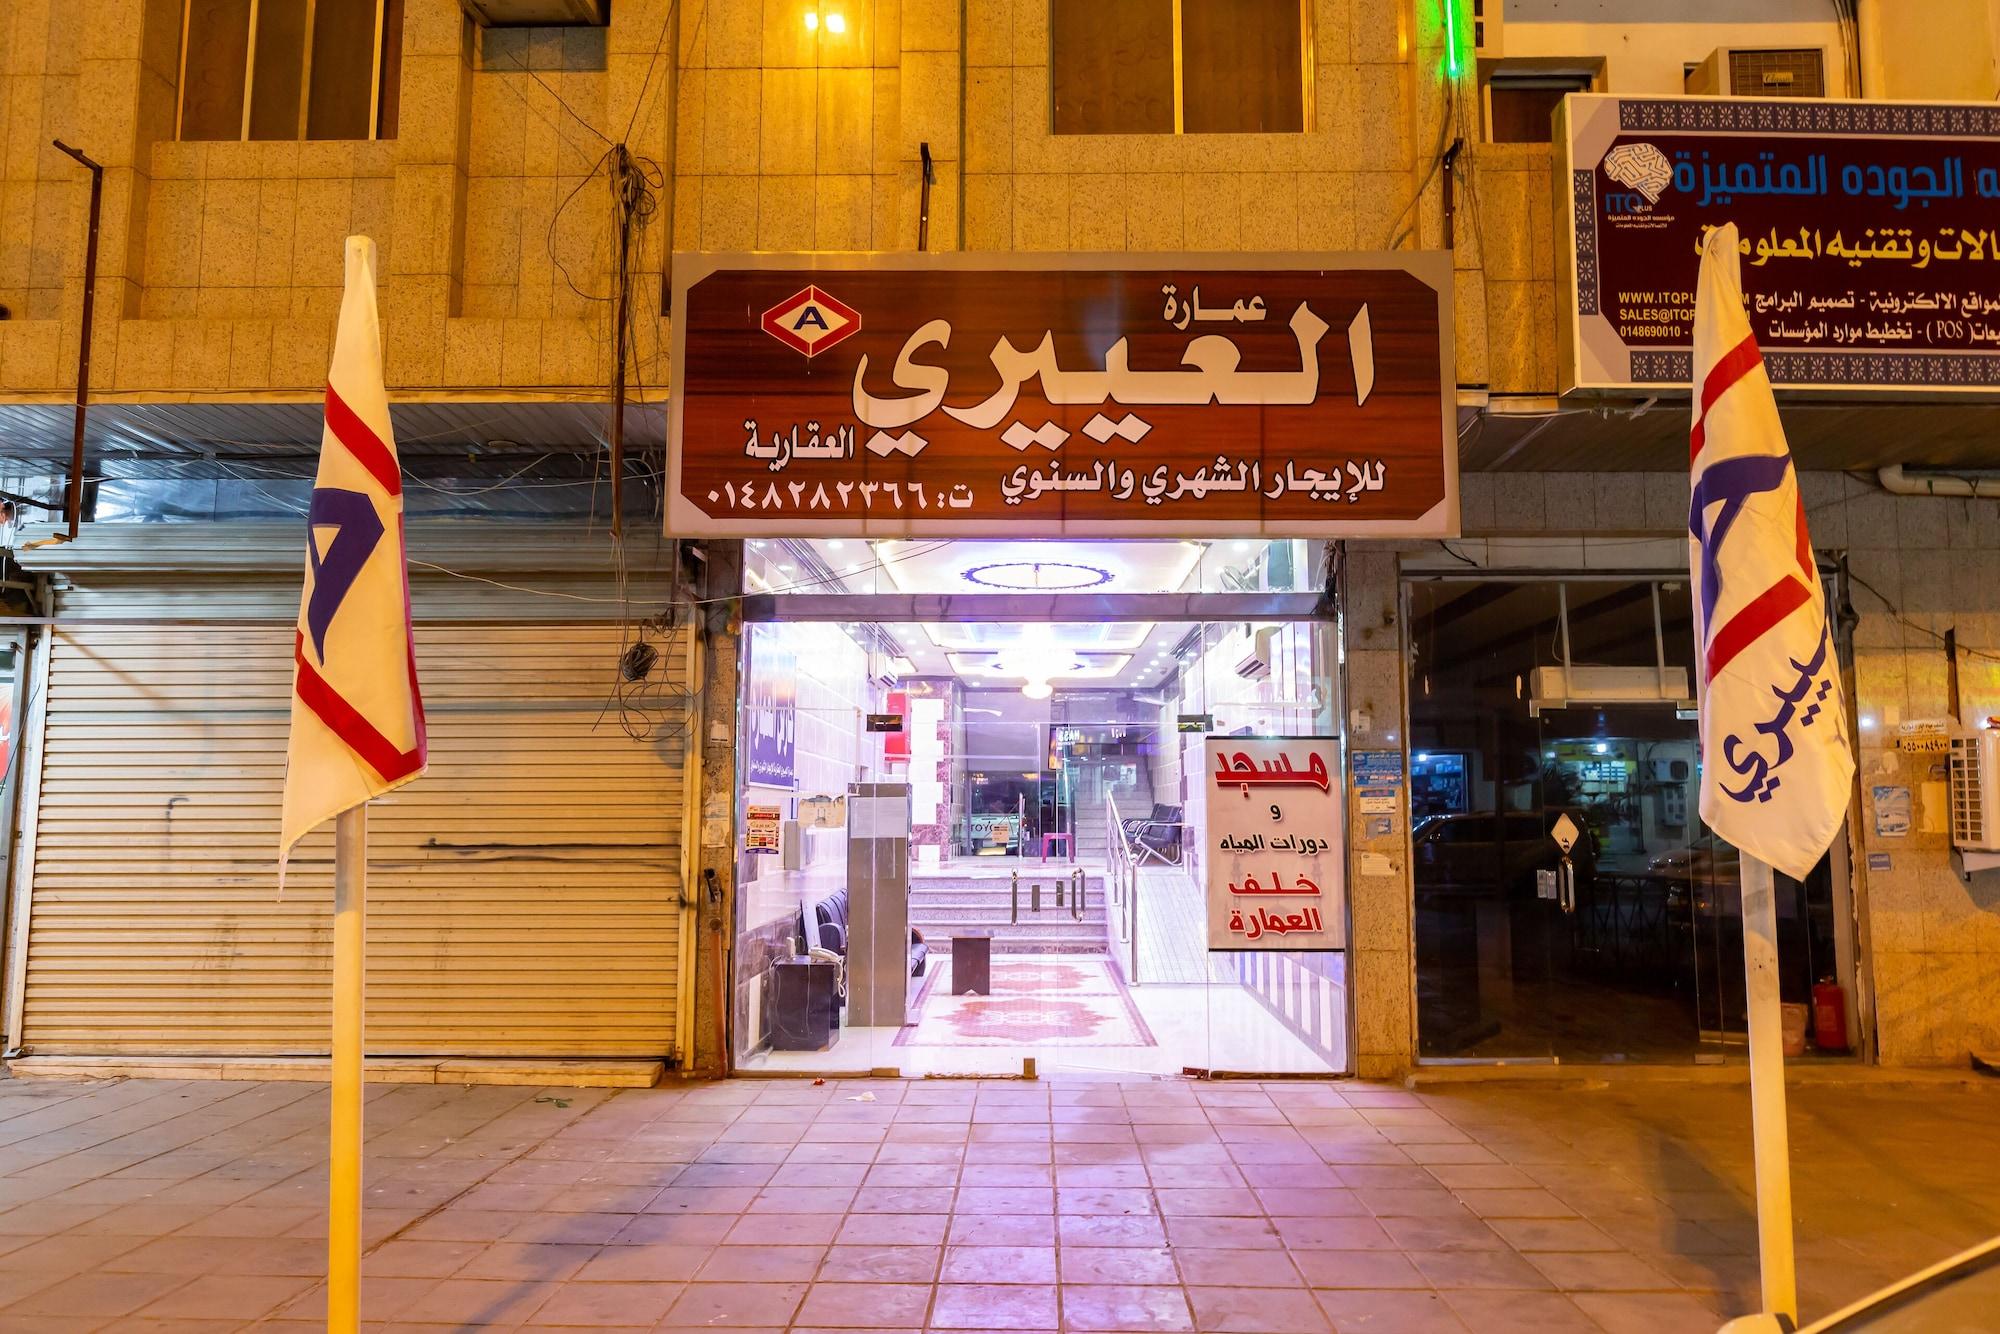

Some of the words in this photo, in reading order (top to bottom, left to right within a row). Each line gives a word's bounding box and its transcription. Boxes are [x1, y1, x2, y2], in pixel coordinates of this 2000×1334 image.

[1674, 151, 1827, 206] المتميزة
[1842, 156, 1963, 210] الجوده
[1694, 224, 1822, 267] المعلومت
[1933, 227, 2000, 261] الات
[1161, 284, 1267, 330] عمارة
[1618, 291, 1750, 304] WWW.ITQPLM
[1755, 289, 1802, 313] البرامج
[1807, 290, 1855, 313] تصميم
[1870, 290, 1957, 314] الالكترونية
[792, 306, 829, 330] A
[1620, 325, 1681, 337] 0148690010
[1768, 319, 1828, 343] المؤسسات
[1832, 321, 1862, 343] موارد
[1865, 321, 1913, 344] تخطيط
[744, 419, 855, 473] العقارية
[1000, 460, 1136, 505] والسنوي
[1142, 455, 1261, 505] الشهري
[1263, 460, 1387, 504] للإيجار
[707, 481, 929, 510] ٠١٤٨٢٨٢٣٦٦
[1215, 752, 1330, 797] مسجد
[1269, 804, 1282, 822] و
[1219, 833, 1265, 853] المياه
[1271, 835, 1329, 855] دورات
[1228, 871, 1322, 897] خلف
[1229, 907, 1324, 939] العمارة
